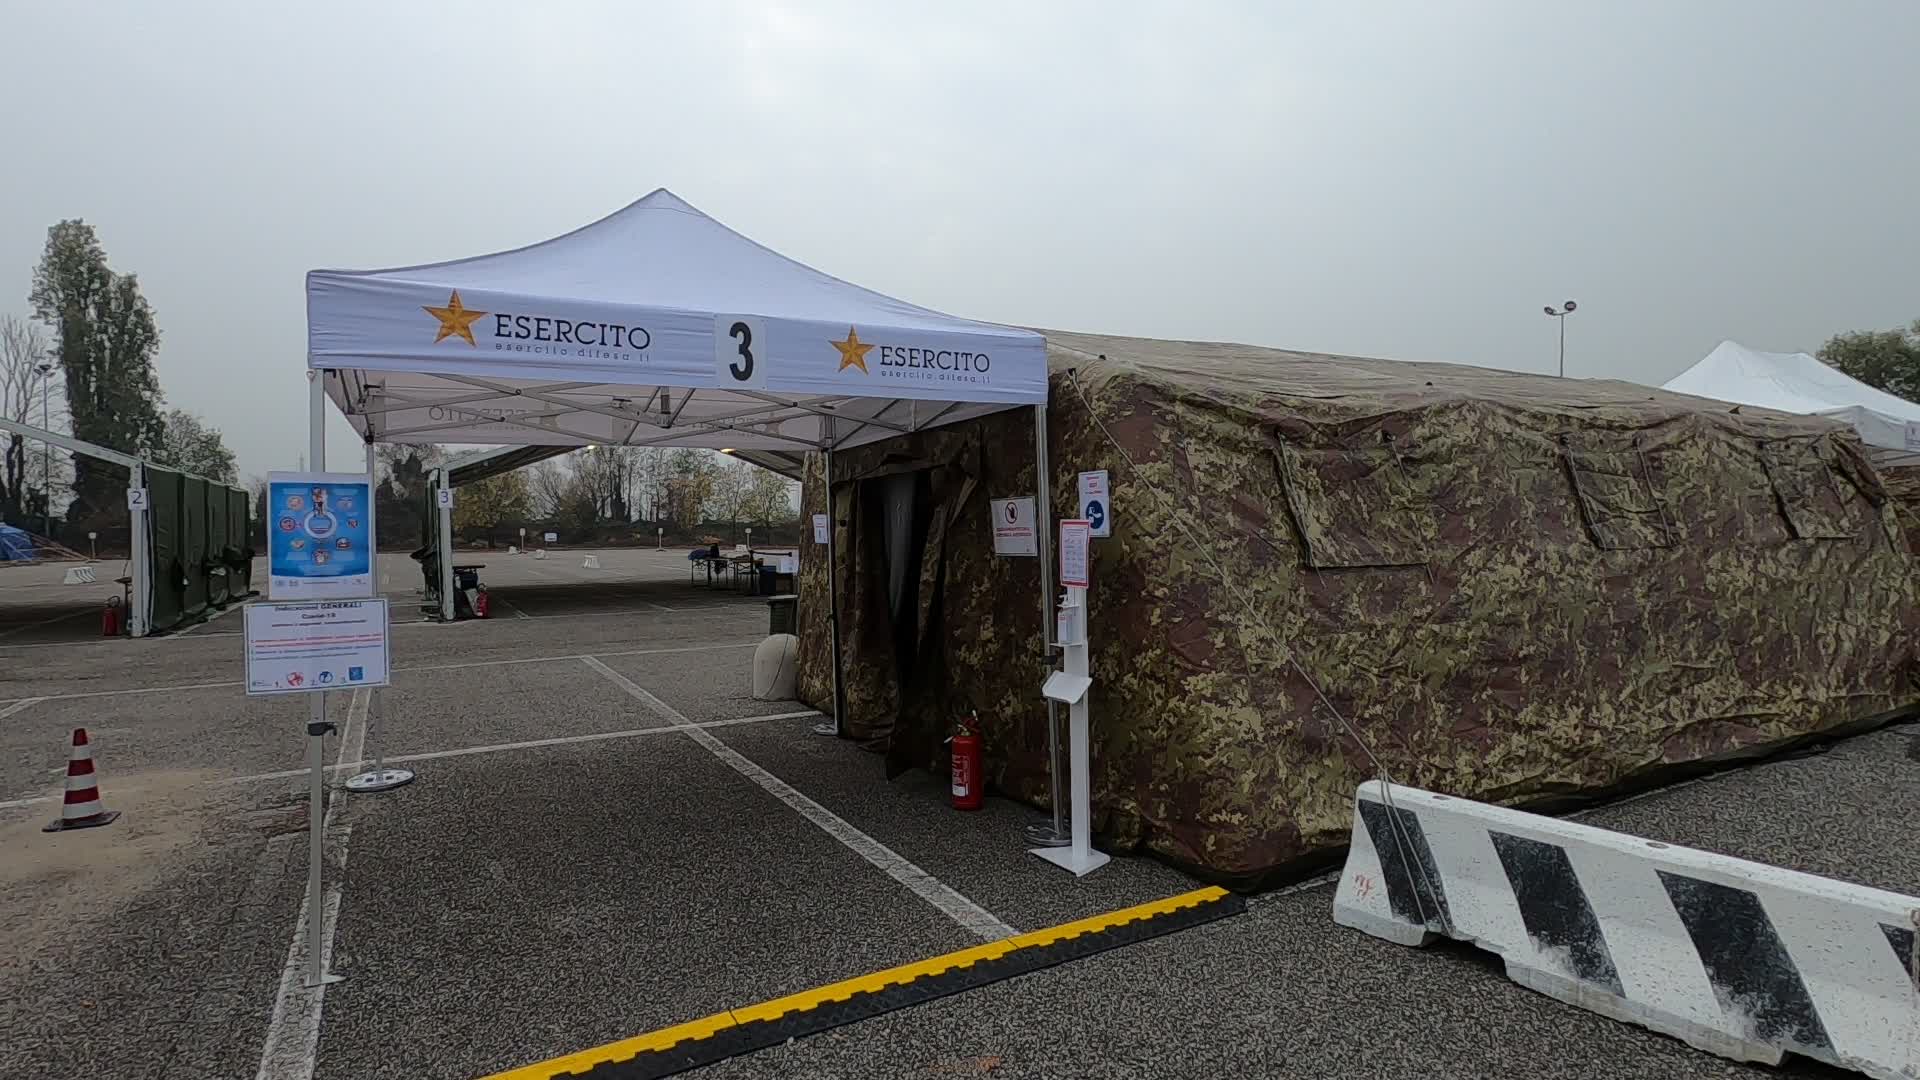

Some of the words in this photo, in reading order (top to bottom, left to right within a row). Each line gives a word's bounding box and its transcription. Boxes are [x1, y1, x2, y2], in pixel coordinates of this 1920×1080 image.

[495, 313, 651, 350] ESERCITO
[728, 320, 755, 381] 3
[880, 346, 990, 373] ESERCITO
[131, 490, 143, 504] 2
[440, 490, 449, 503] 3
